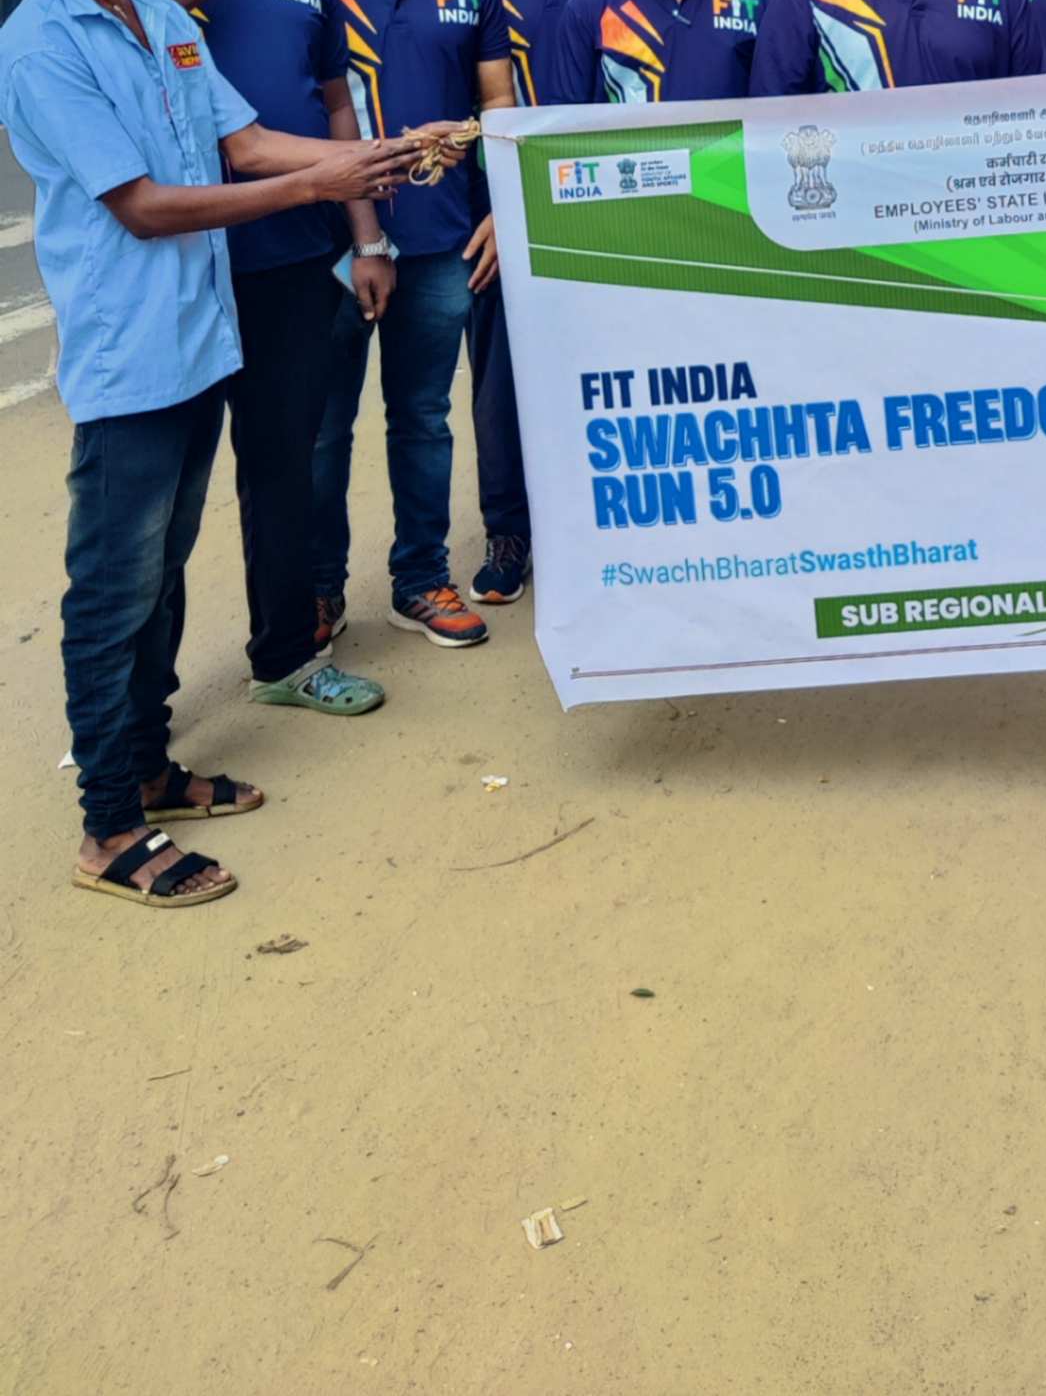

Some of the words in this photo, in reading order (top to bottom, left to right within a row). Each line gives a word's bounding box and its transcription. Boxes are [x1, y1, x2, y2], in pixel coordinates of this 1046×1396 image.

[438, 8, 480, 26] INDIA
[713, 15, 757, 35] INDIA
[957, 4, 1003, 25] INDIA
[986, 150, 1037, 170] कर्मचारी
[1000, 169, 1046, 187] रोजगार
[560, 186, 602, 199] INDIA
[874, 198, 981, 219] EMPLOYEES'
[986, 192, 1038, 210] STATE
[914, 216, 968, 234] (Ministry
[973, 214, 985, 227] of
[988, 211, 1034, 226] Labour
[580, 370, 635, 410] FIT
[648, 361, 757, 405] INDIA
[586, 397, 872, 472] SWACHHTA
[592, 470, 697, 529] RUN
[708, 464, 782, 522] 5.0
[601, 539, 978, 587] #SwachhBharatSwasthBharat
[841, 603, 898, 628] SUB
